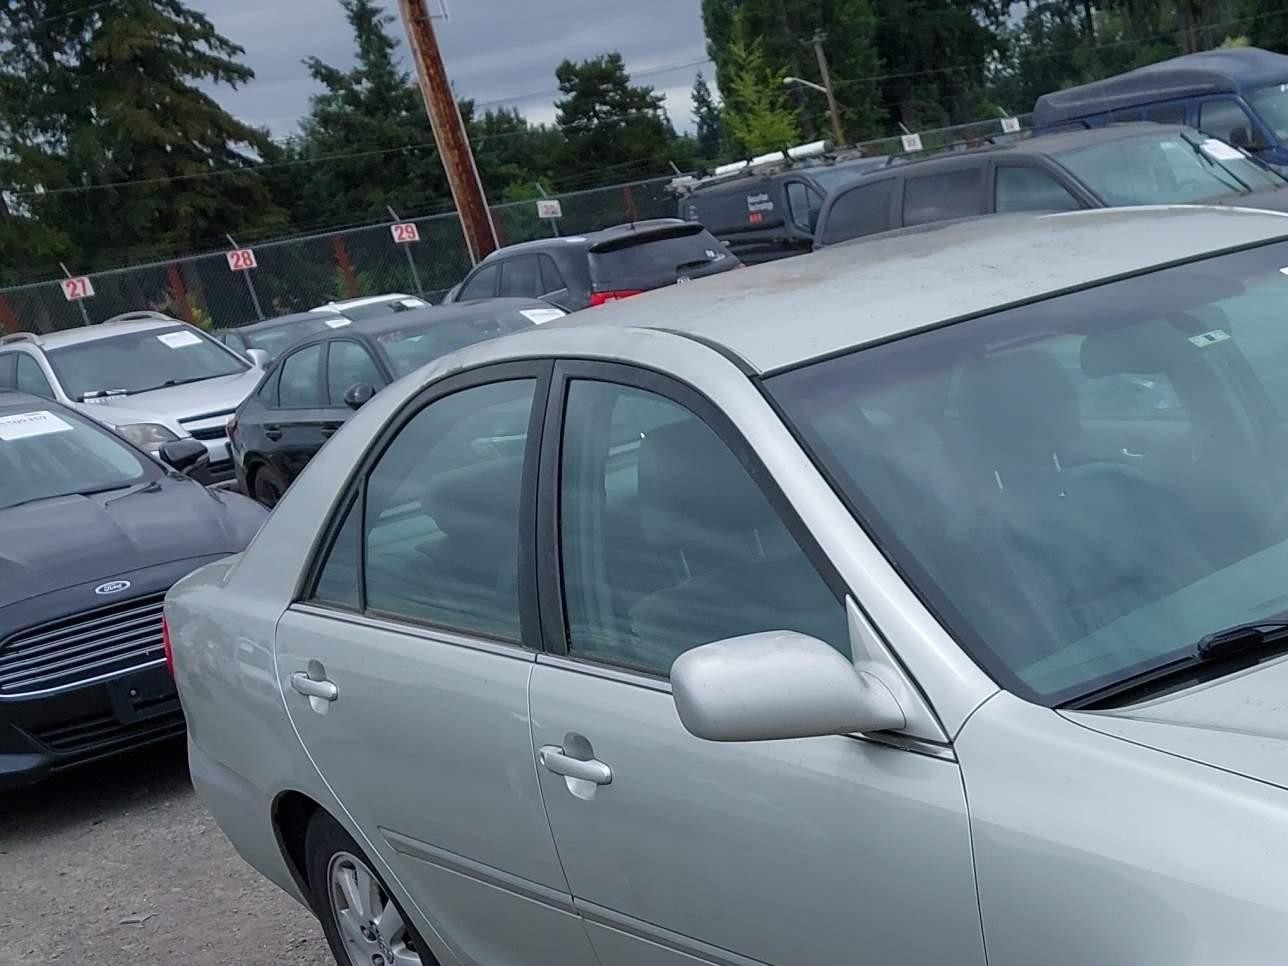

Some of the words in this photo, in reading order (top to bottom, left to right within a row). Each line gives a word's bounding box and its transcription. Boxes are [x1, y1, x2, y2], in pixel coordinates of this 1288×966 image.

[395, 224, 416, 240] 29
[230, 251, 253, 268] 28
[66, 280, 87, 298] 27
